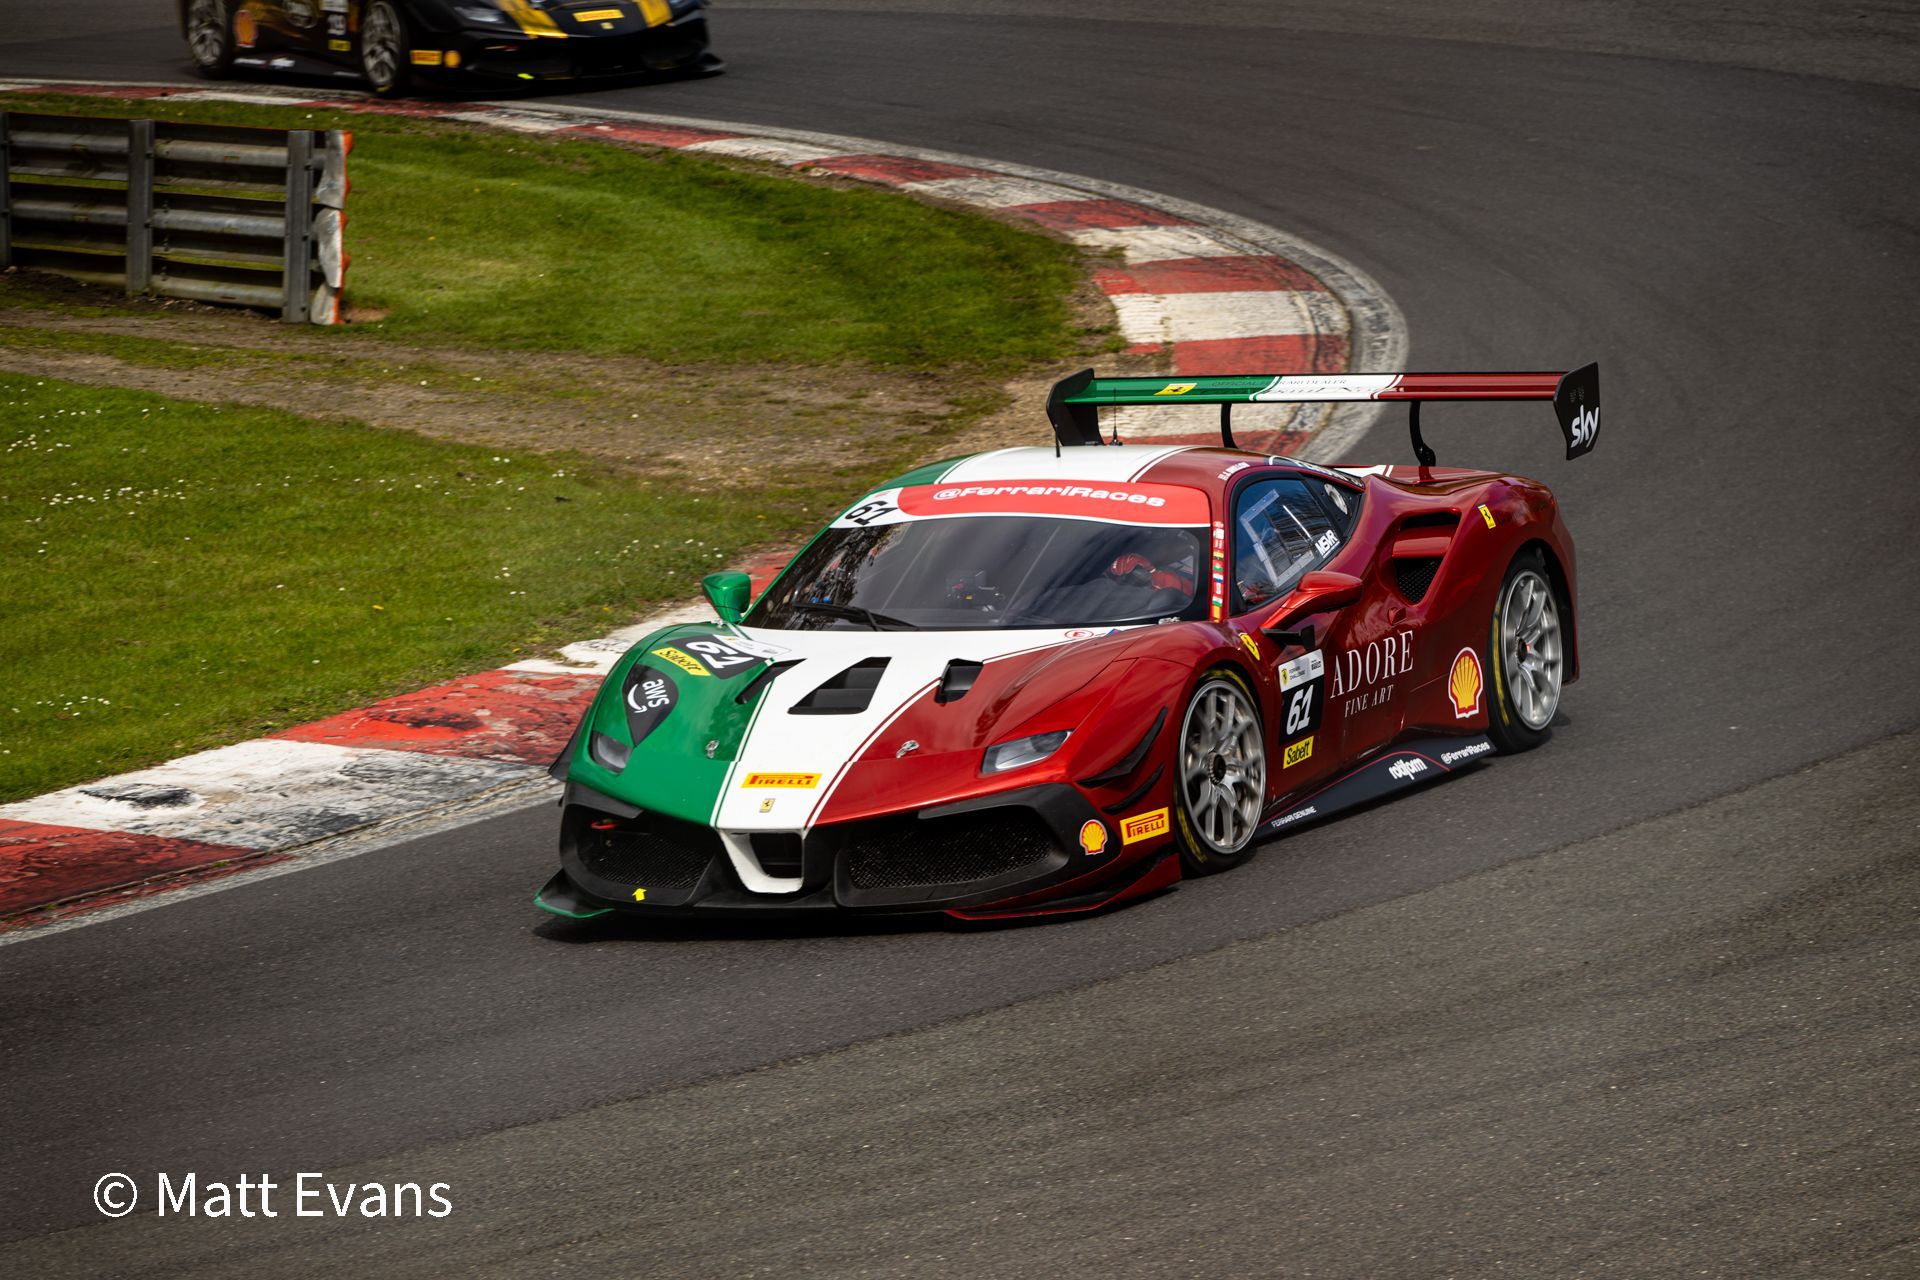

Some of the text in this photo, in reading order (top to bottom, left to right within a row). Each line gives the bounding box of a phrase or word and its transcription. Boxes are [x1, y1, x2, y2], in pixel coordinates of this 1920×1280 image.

[1570, 404, 1600, 448] sky
[933, 485, 1166, 509] @FerrariRaces
[845, 500, 898, 526] 61
[1315, 529, 1338, 557] MSVR
[685, 641, 755, 670] 61
[1330, 630, 1414, 699] ADORE
[642, 678, 670, 708] aws
[1345, 684, 1394, 718] FINE ART
[1286, 685, 1314, 735] 61
[1286, 740, 1311, 765] Sabelt
[1440, 741, 1491, 764] @FerrariRaces
[749, 775, 814, 786] PIRELLI
[1125, 813, 1165, 838] PIRELLI
